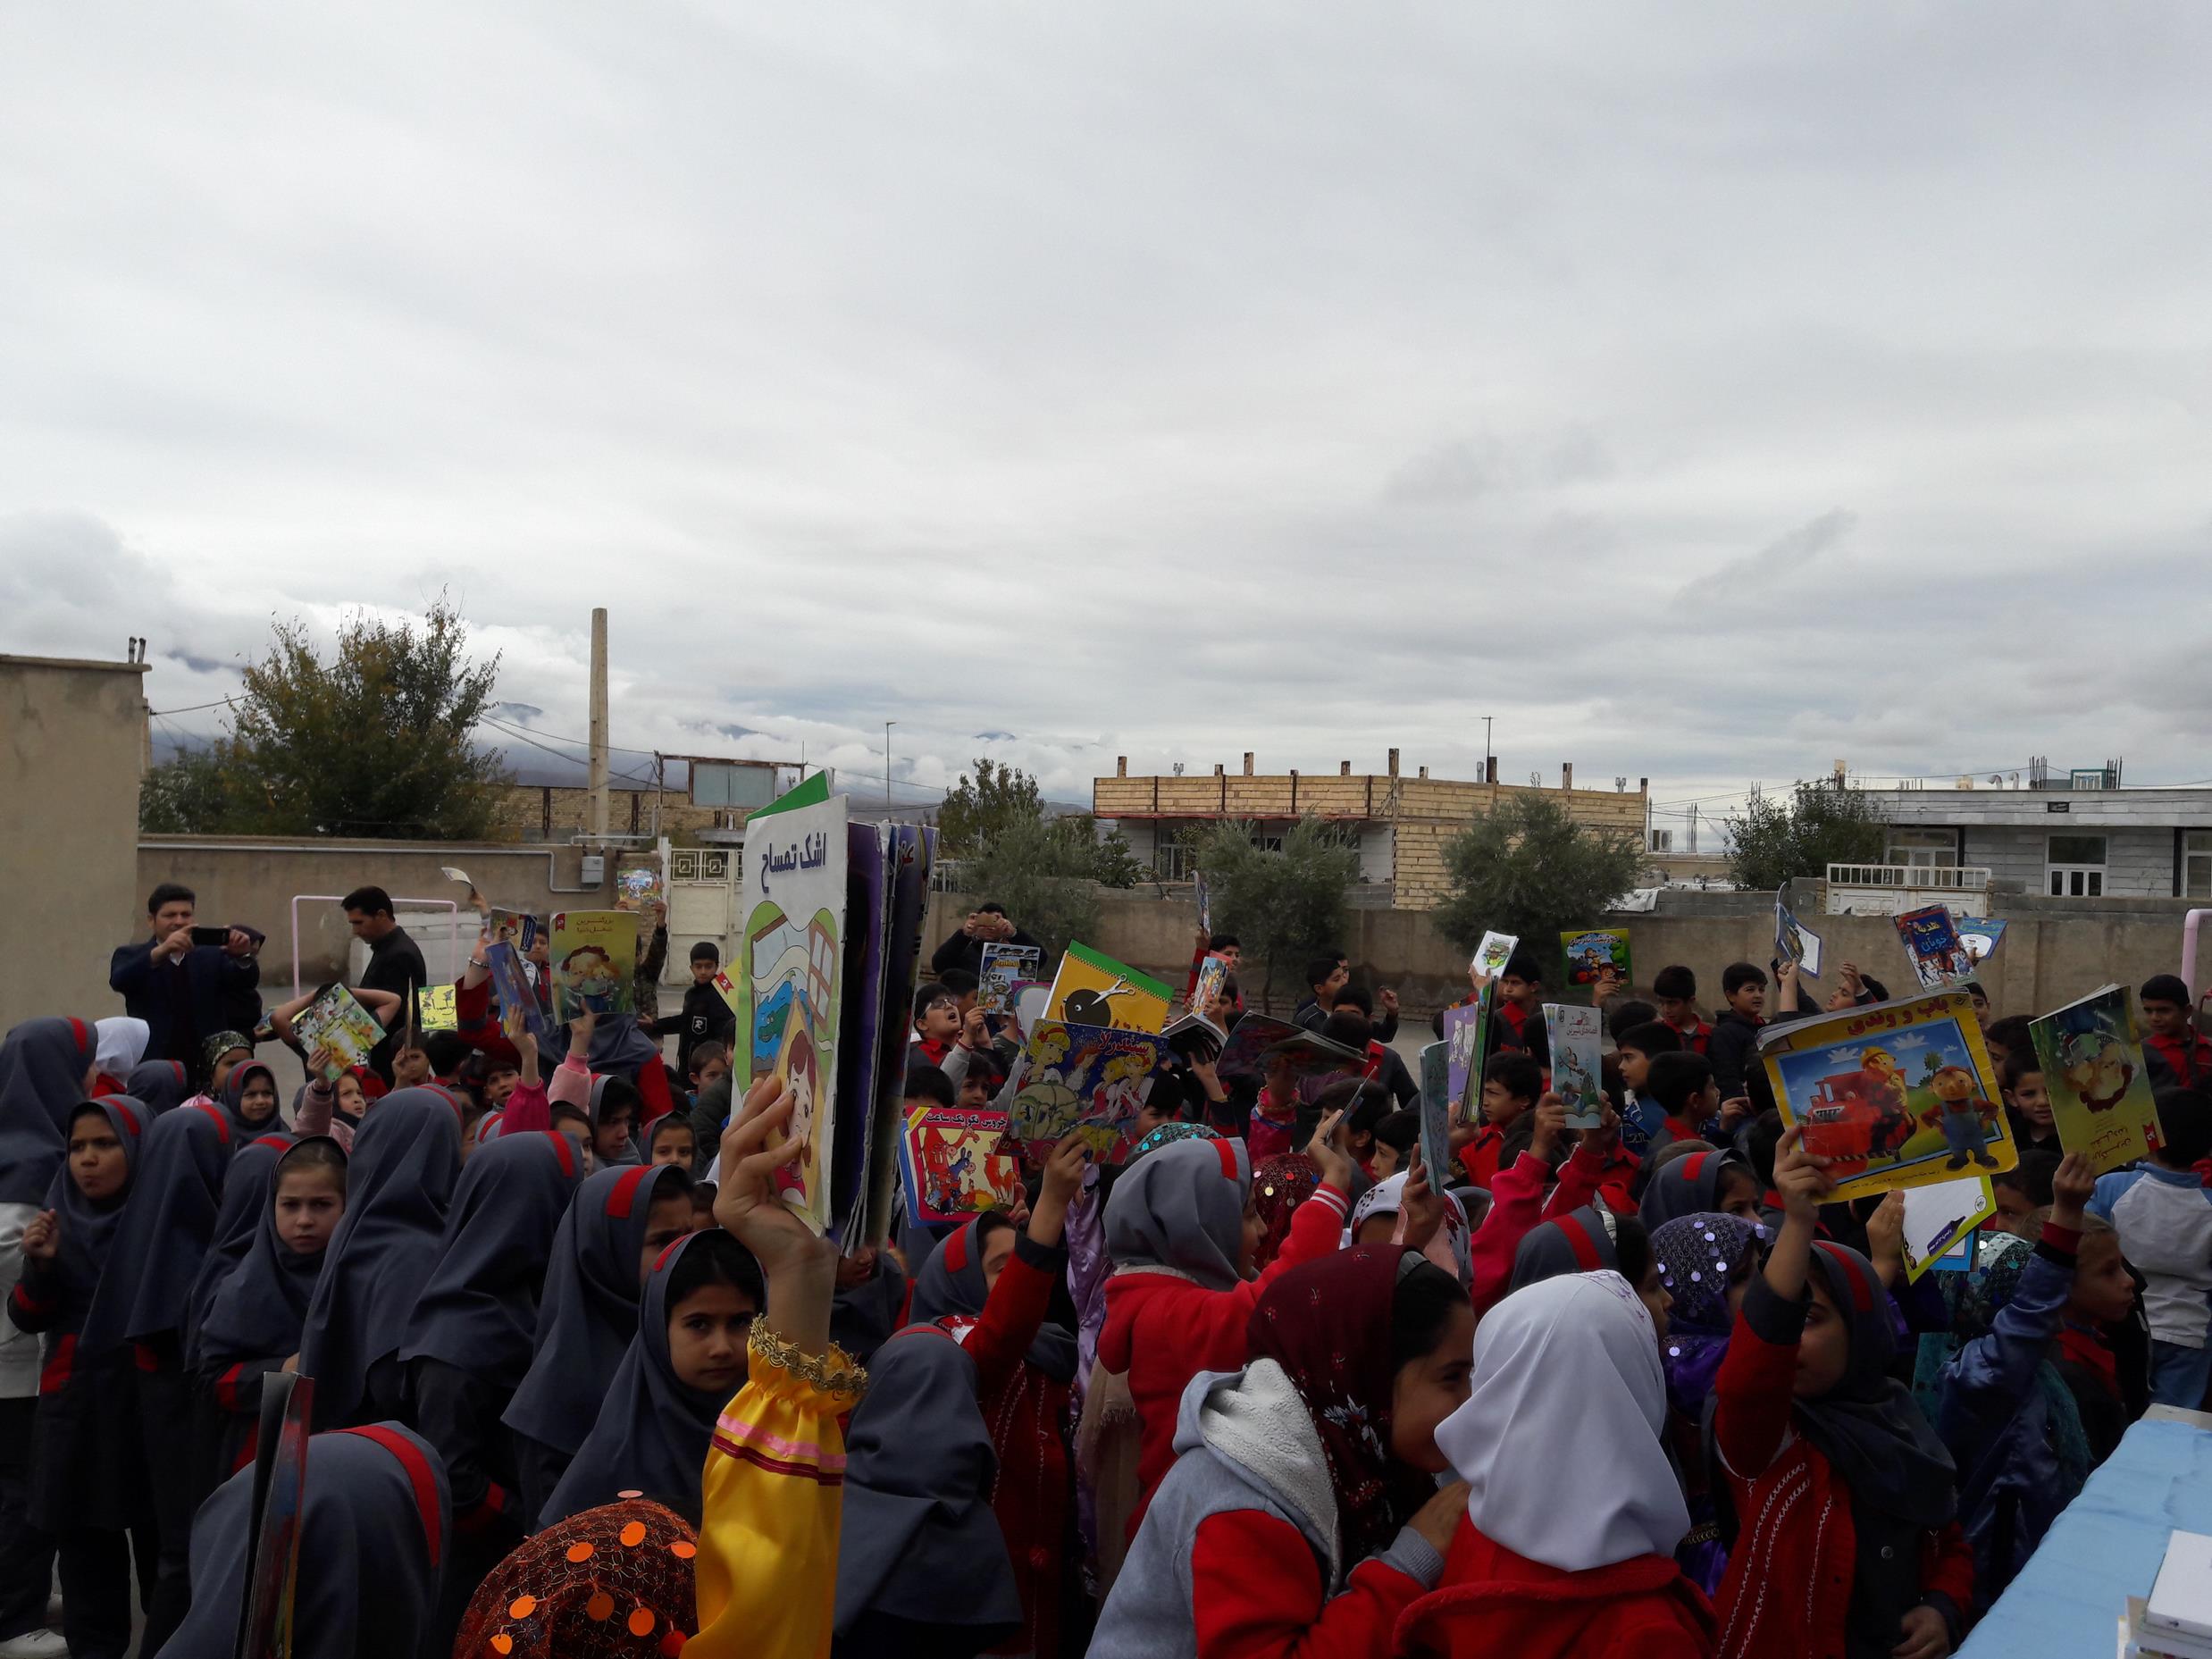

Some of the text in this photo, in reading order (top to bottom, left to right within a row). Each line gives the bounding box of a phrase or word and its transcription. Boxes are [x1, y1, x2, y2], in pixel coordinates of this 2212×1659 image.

[760, 831, 827, 894] اشک تمساح
[1902, 1010, 1913, 1025] و
[926, 1112, 951, 1123] ساعت
[981, 1116, 1007, 1129] خروس
